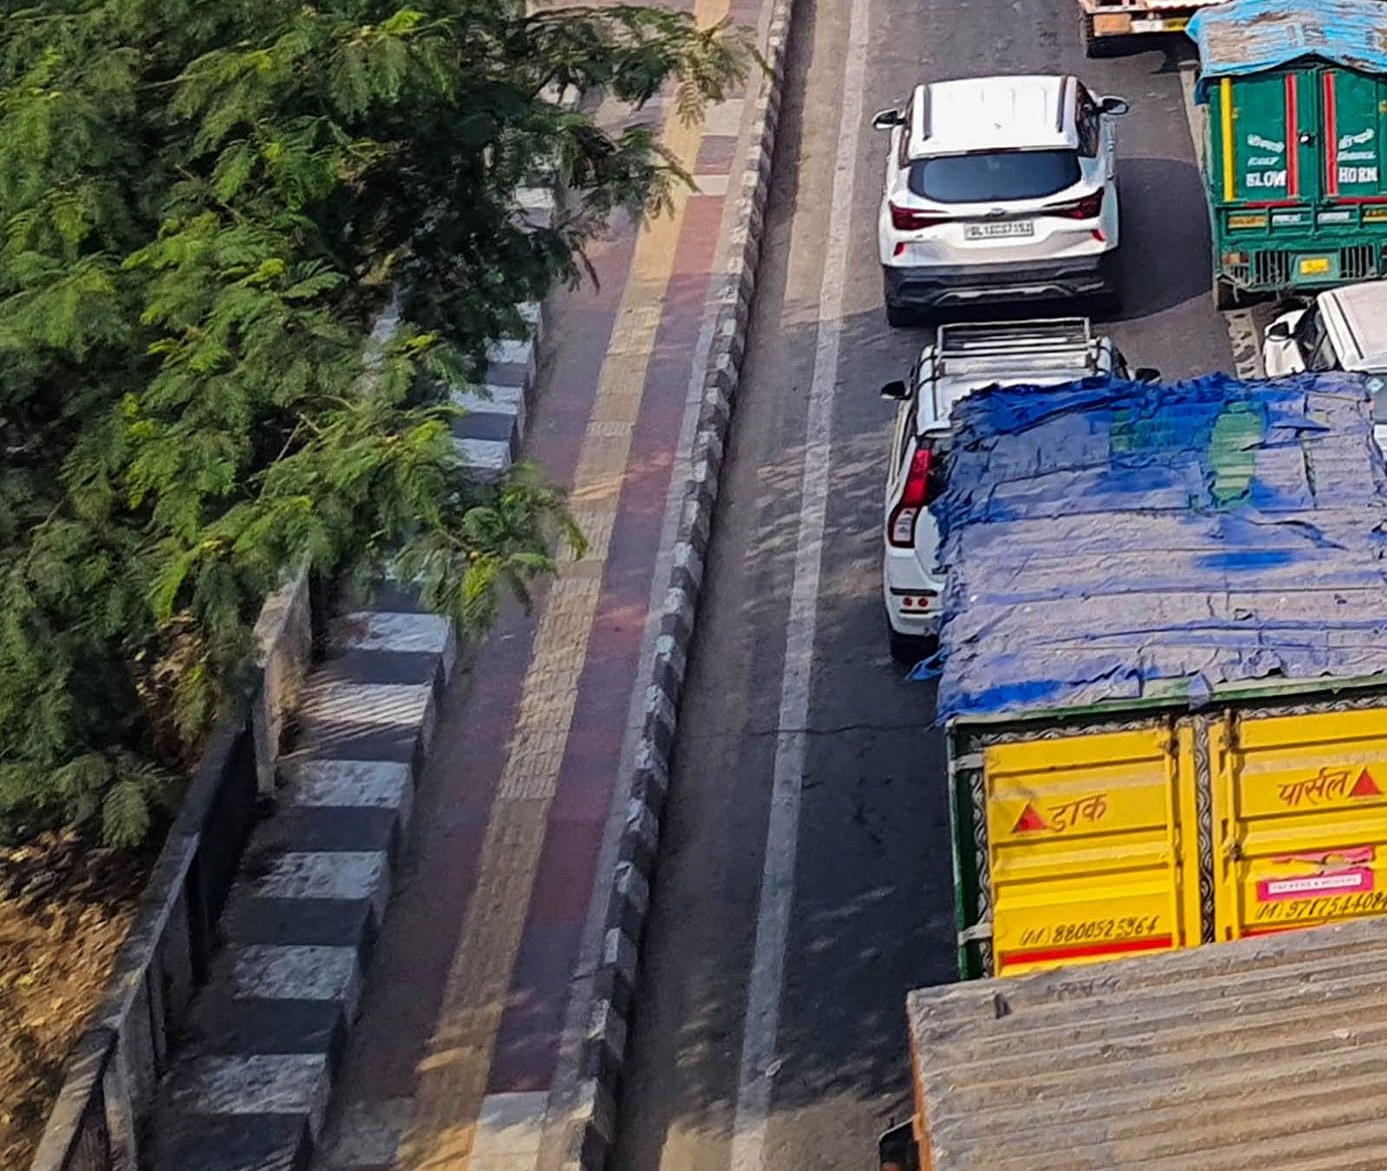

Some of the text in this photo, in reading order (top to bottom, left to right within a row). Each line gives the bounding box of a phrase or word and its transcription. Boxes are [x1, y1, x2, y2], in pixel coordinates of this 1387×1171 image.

[1338, 167, 1378, 183] HORN
[1276, 767, 1352, 806] पार्सल
[1047, 793, 1108, 832] डाक
